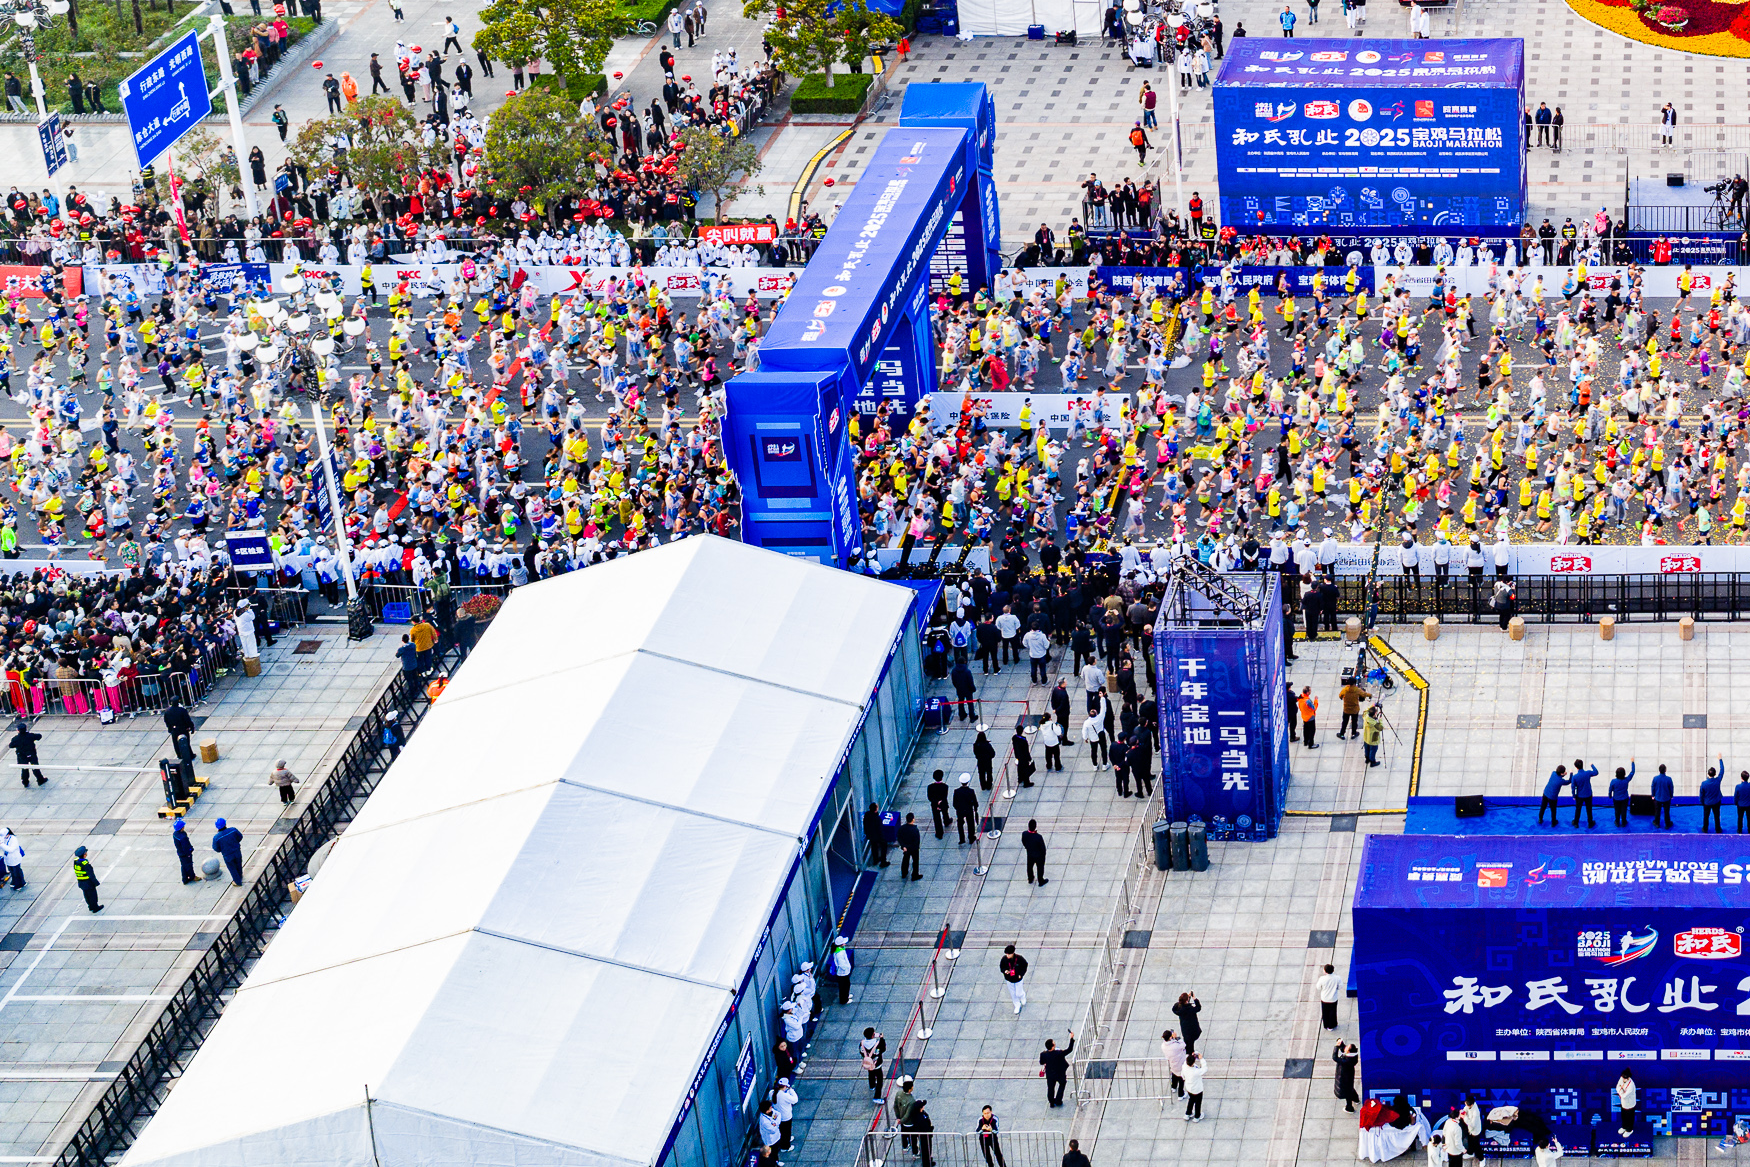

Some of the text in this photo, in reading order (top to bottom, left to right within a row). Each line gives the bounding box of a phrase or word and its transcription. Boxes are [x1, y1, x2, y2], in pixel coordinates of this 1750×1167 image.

[1245, 65, 1344, 76] 和氏乳业
[1350, 67, 1412, 77] 2025
[136, 116, 161, 144] 陈仓大道
[1232, 127, 1502, 147] 和氏乳业 2025 宝鸡马拉松
[860, 213, 888, 238] 2025
[706, 228, 774, 243] 尖叫就赢
[1112, 275, 1173, 287] 陕西体育局
[1201, 275, 1273, 287] 宝鸡人民政府
[1553, 557, 1590, 573] 和氏
[1662, 557, 1700, 573] 和氏
[1178, 658, 1211, 745] 千年宝地
[1217, 710, 1250, 791] 一马当先
[1583, 860, 1718, 871] BAOJI MARATHON
[1583, 869, 1719, 885] 宝鸡马拉松
[1578, 931, 1610, 939] 2025
[1578, 939, 1610, 947] BAOJI
[1678, 935, 1737, 953] 和氏
[1444, 976, 1719, 1015] 和氏乳业
[1592, 1028, 1648, 1036] 宝鸡市人民政府
